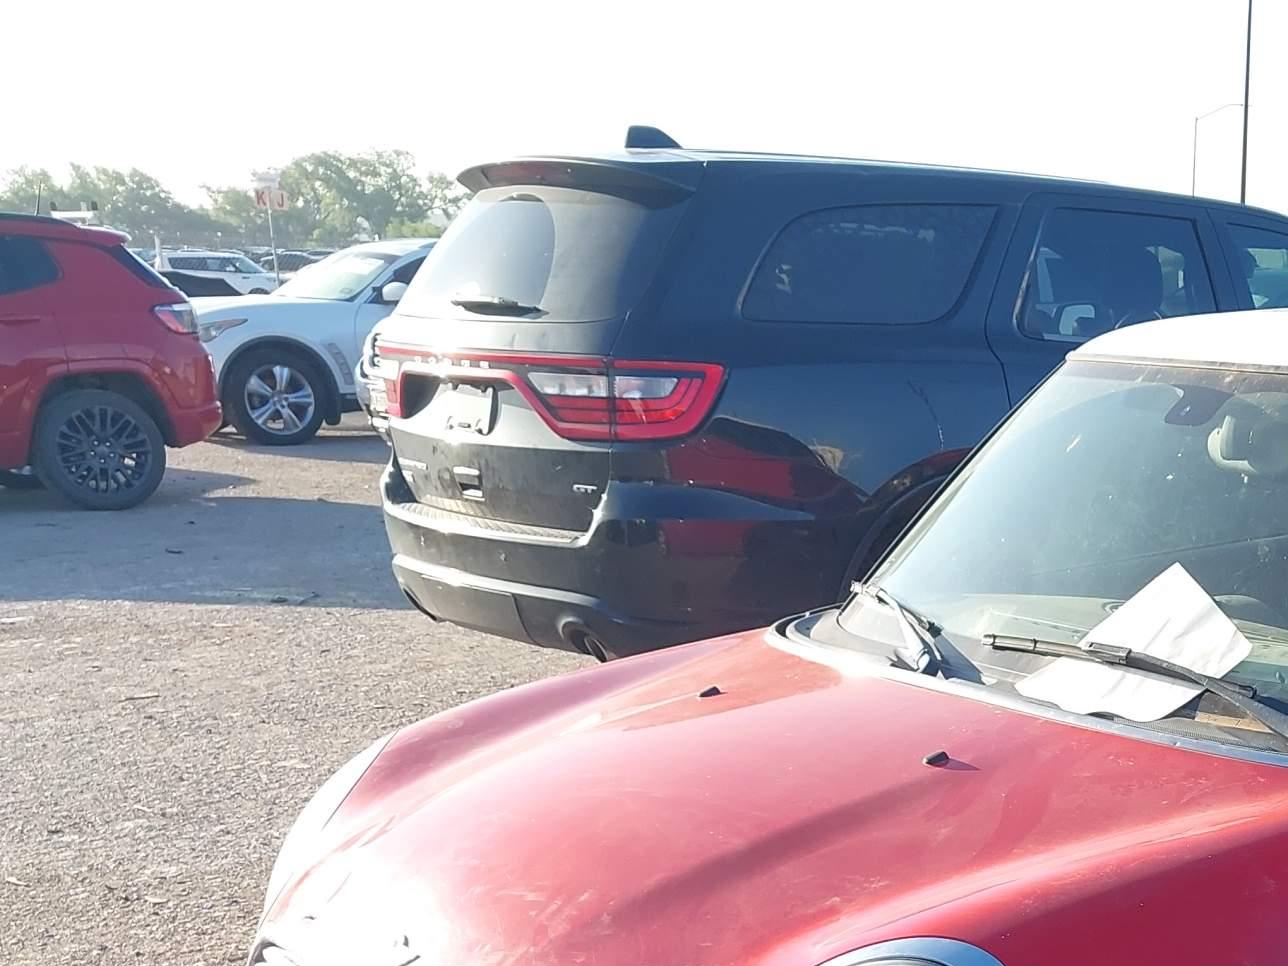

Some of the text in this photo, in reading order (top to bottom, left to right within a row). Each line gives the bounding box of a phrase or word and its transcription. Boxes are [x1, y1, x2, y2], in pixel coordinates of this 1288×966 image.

[256, 190, 266, 206] K
[276, 192, 284, 208] J
[572, 484, 598, 494] GT
